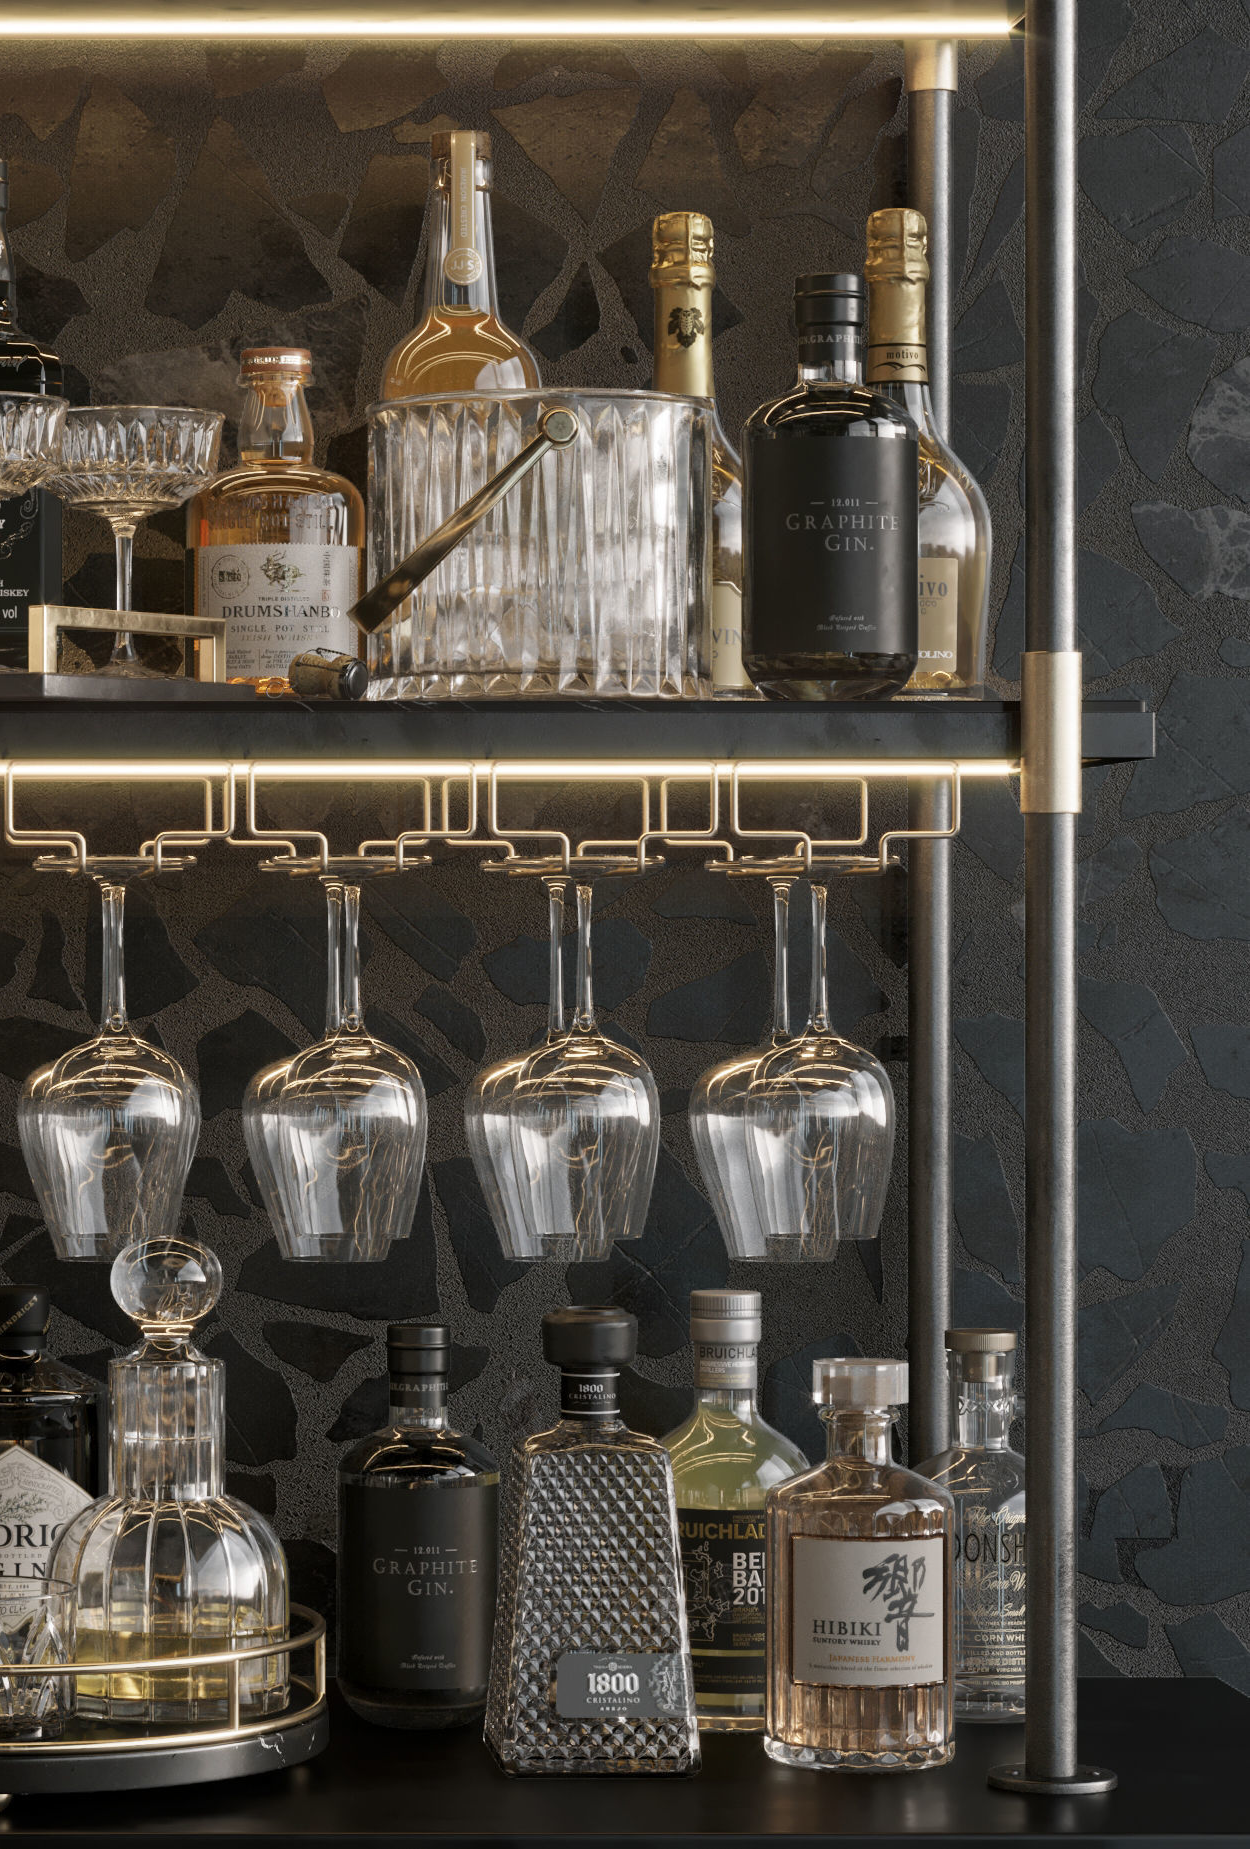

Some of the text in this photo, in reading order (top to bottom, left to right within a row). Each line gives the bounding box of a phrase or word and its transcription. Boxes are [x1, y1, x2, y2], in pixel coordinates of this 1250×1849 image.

[886, 348, 919, 360] motivo
[831, 498, 860, 507] 12.011
[786, 513, 900, 531] GRAPHITE
[824, 534, 875, 552] GIN.
[2, 604, 18, 619] vol
[221, 604, 341, 619] DRUMSHANBO
[230, 624, 266, 632] SINGLE
[275, 624, 295, 632] POT
[578, 1383, 605, 1394] 1800
[568, 1392, 617, 1400] CRISTALINO
[413, 1546, 441, 1555] 12.011
[372, 1557, 479, 1576] GRAPHITE
[406, 1579, 454, 1597] GIN.
[812, 1619, 882, 1636] HIBIKI
[812, 1636, 882, 1647] SUNTORY WHISKY
[829, 1654, 917, 1664] JAPANESE HARMONY
[586, 1672, 640, 1695] 1800
[586, 1696, 642, 1704] CRISTALINO
